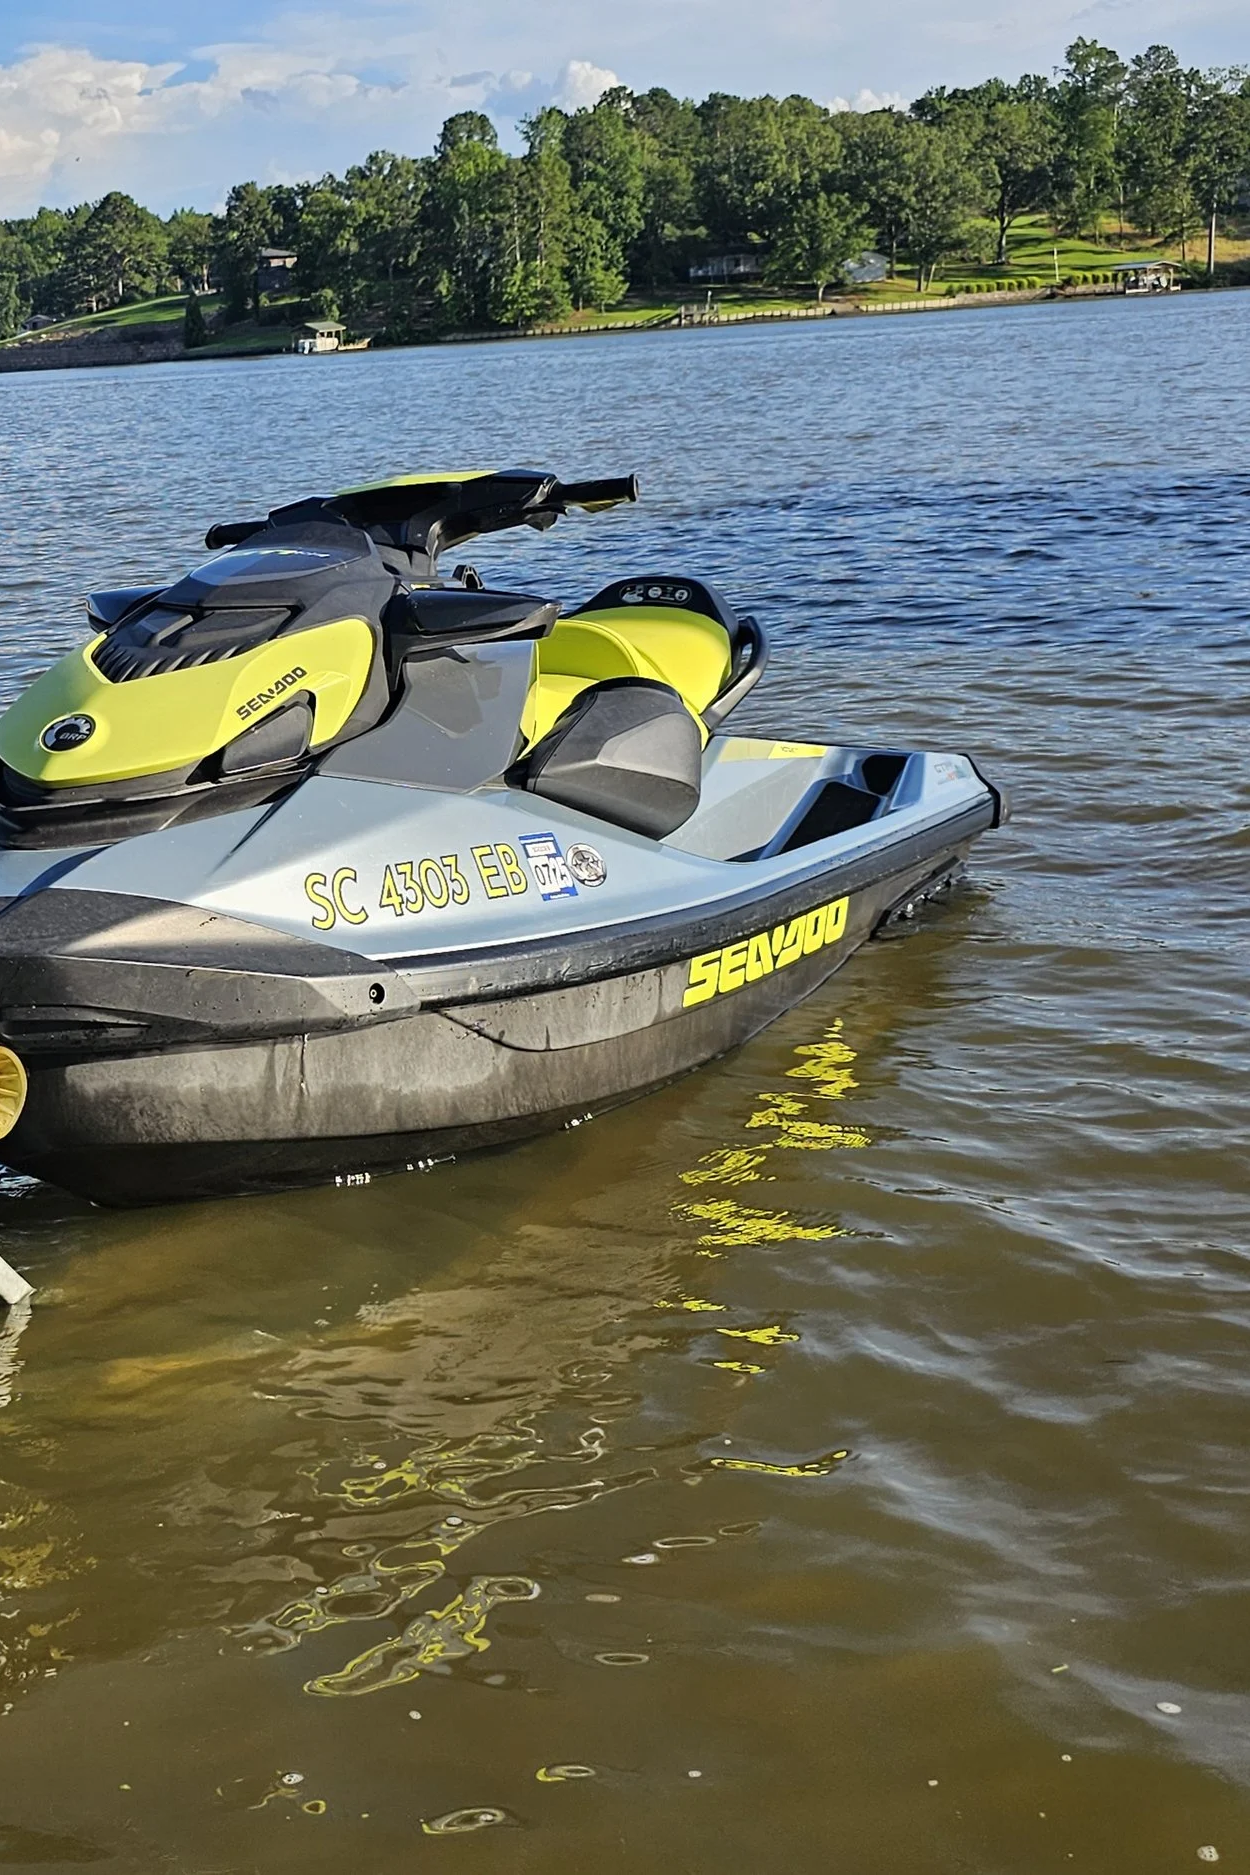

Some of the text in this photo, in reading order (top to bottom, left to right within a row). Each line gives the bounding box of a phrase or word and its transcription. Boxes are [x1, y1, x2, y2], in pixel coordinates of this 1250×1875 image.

[304, 843, 528, 930] SC 4303 EB
